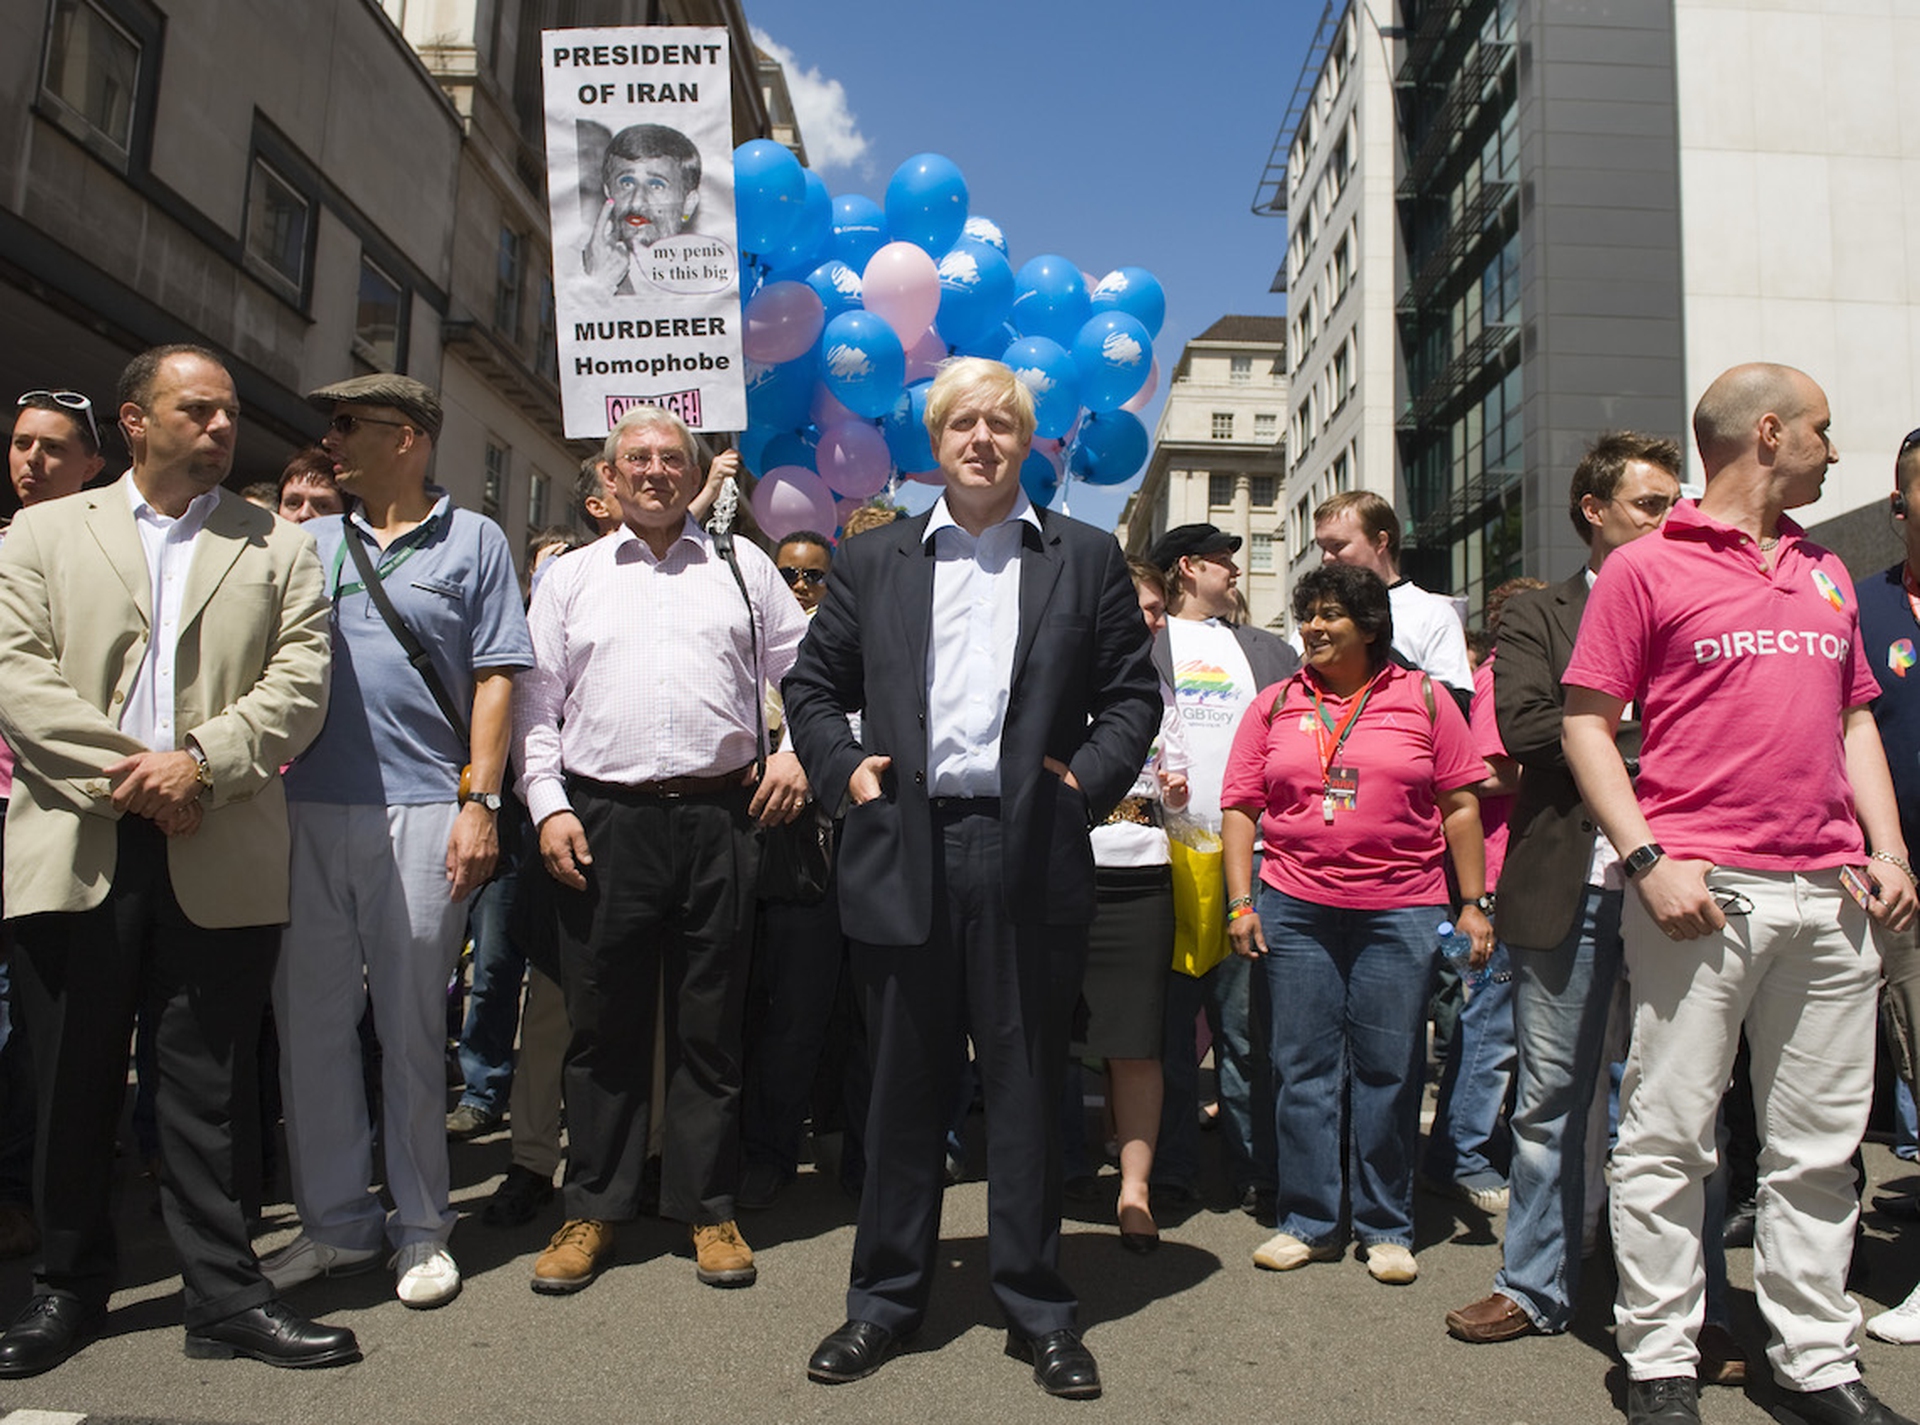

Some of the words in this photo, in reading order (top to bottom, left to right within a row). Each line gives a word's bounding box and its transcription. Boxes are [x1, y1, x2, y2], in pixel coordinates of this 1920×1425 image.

[553, 44, 721, 67] PRESIDENT
[578, 84, 615, 104] OF
[627, 83, 699, 103] IRAN
[654, 248, 677, 262] my
[683, 242, 725, 261] penis
[652, 267, 664, 280] is
[670, 265, 698, 280] this
[703, 264, 728, 281] big
[575, 317, 726, 341] MURDERER
[575, 352, 730, 377] Homophobe
[611, 391, 697, 425] OGE!
[1694, 629, 1850, 665] DIRECTOR
[1182, 706, 1234, 725] GBTory
